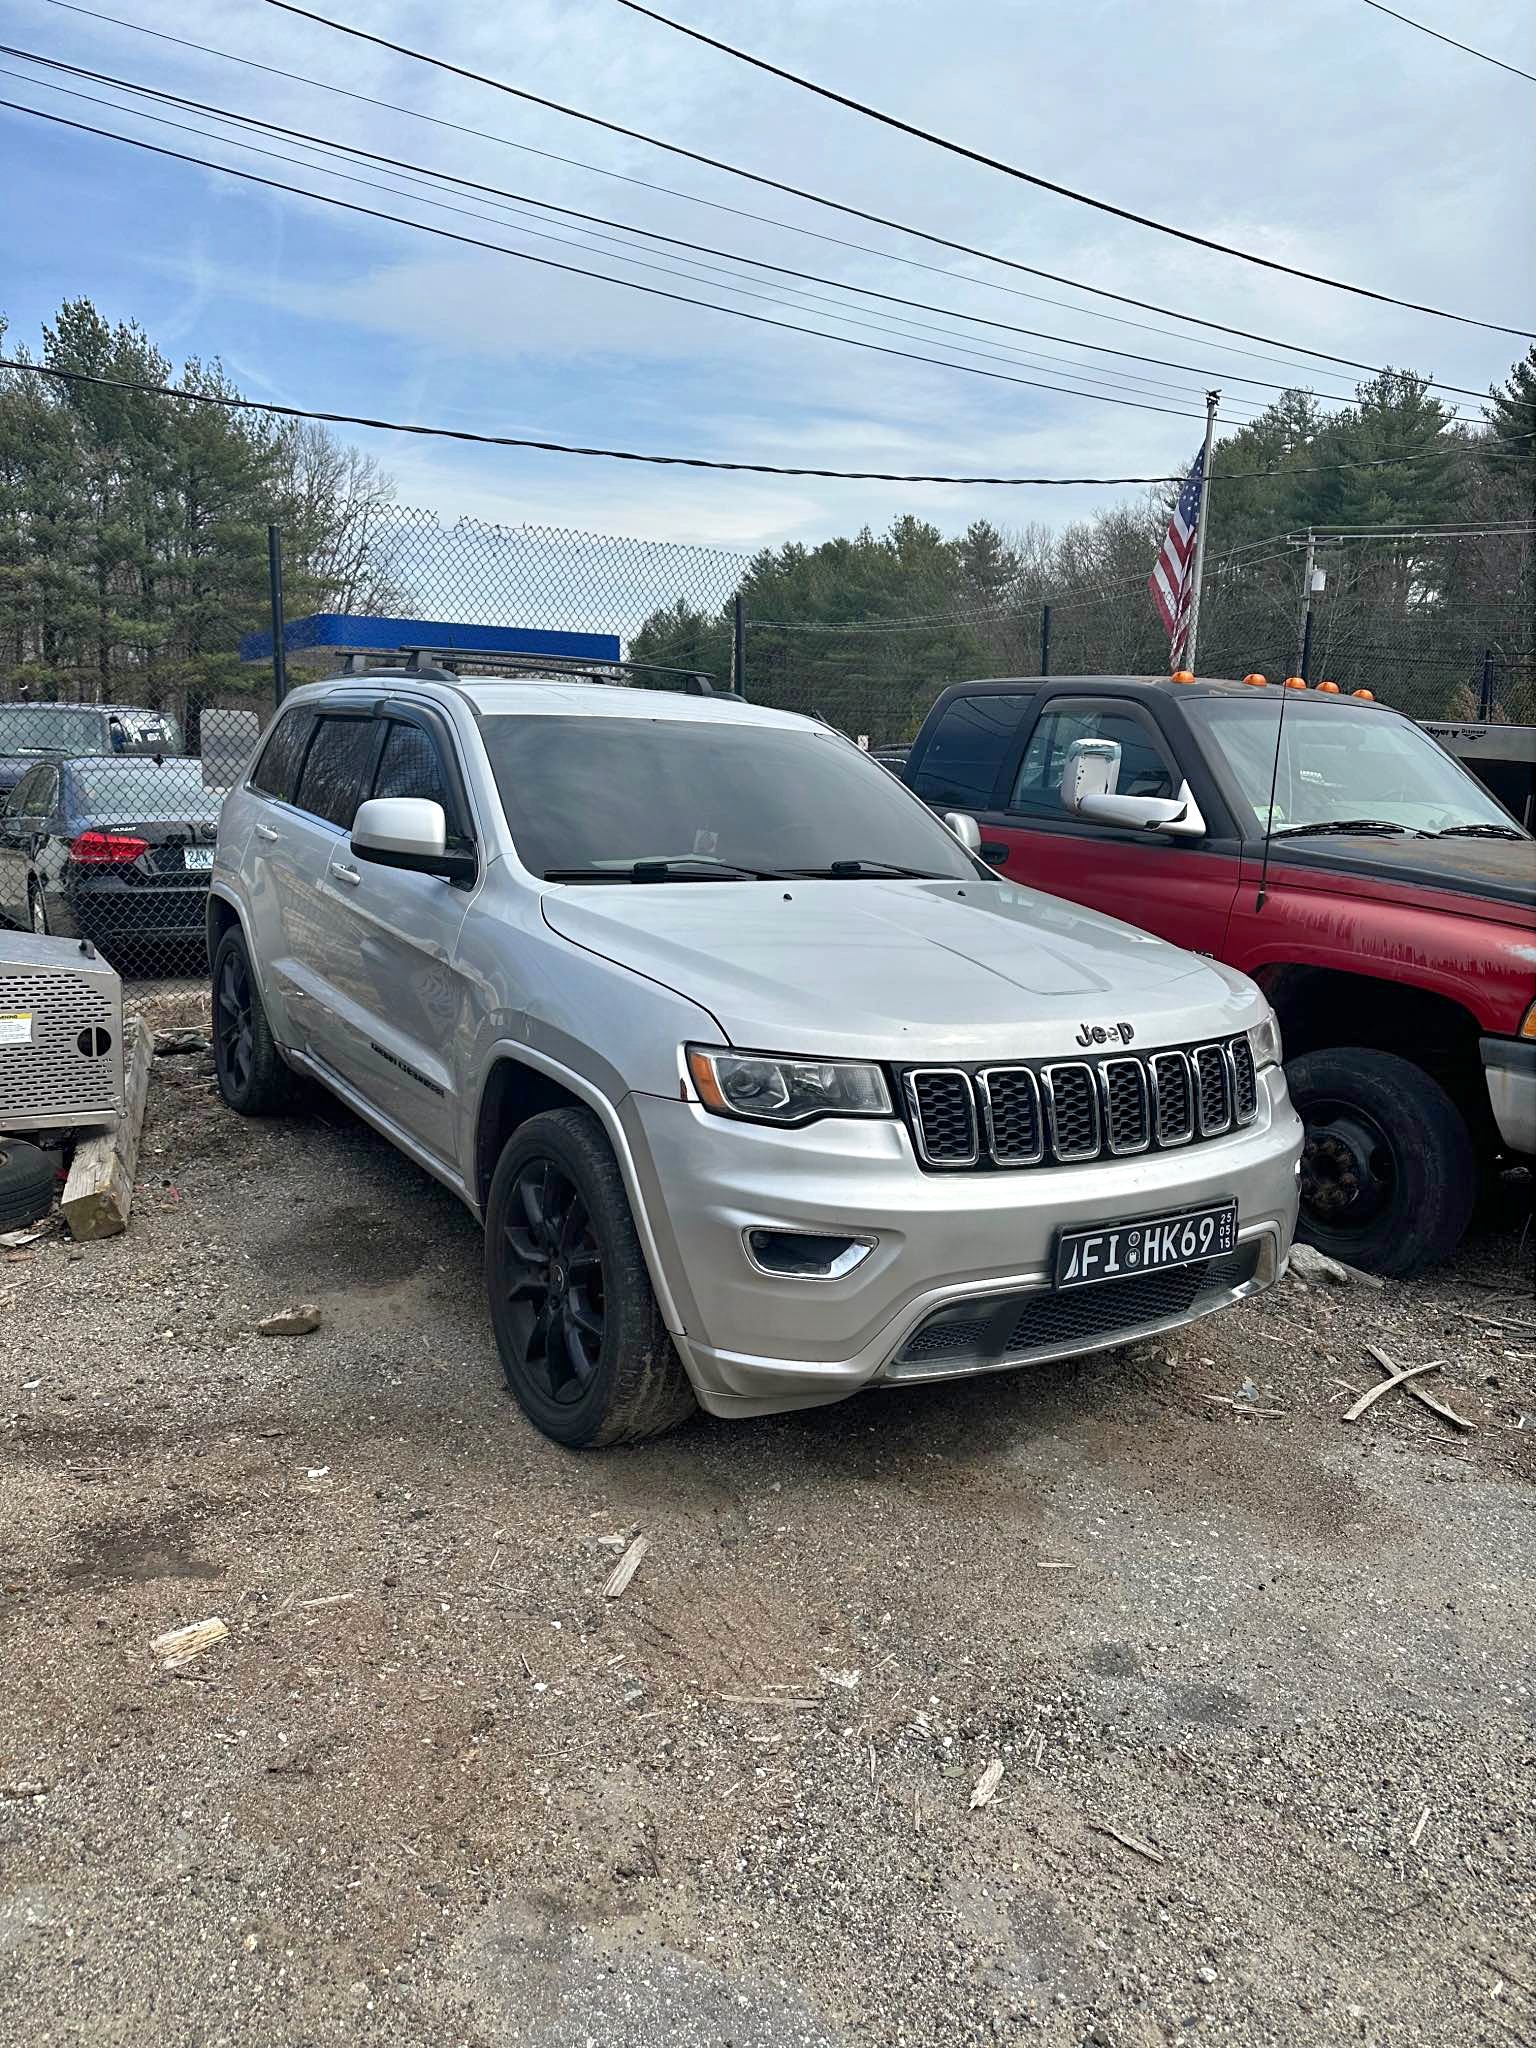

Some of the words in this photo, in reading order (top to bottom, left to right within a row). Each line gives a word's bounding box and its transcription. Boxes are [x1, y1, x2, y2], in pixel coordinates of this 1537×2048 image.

[1075, 1022, 1134, 1047] Jeep
[1220, 1213, 1232, 1224] 25
[1219, 1226, 1231, 1237] 05
[1143, 1217, 1215, 1266] HK69
[1220, 1239, 1231, 1249] 15
